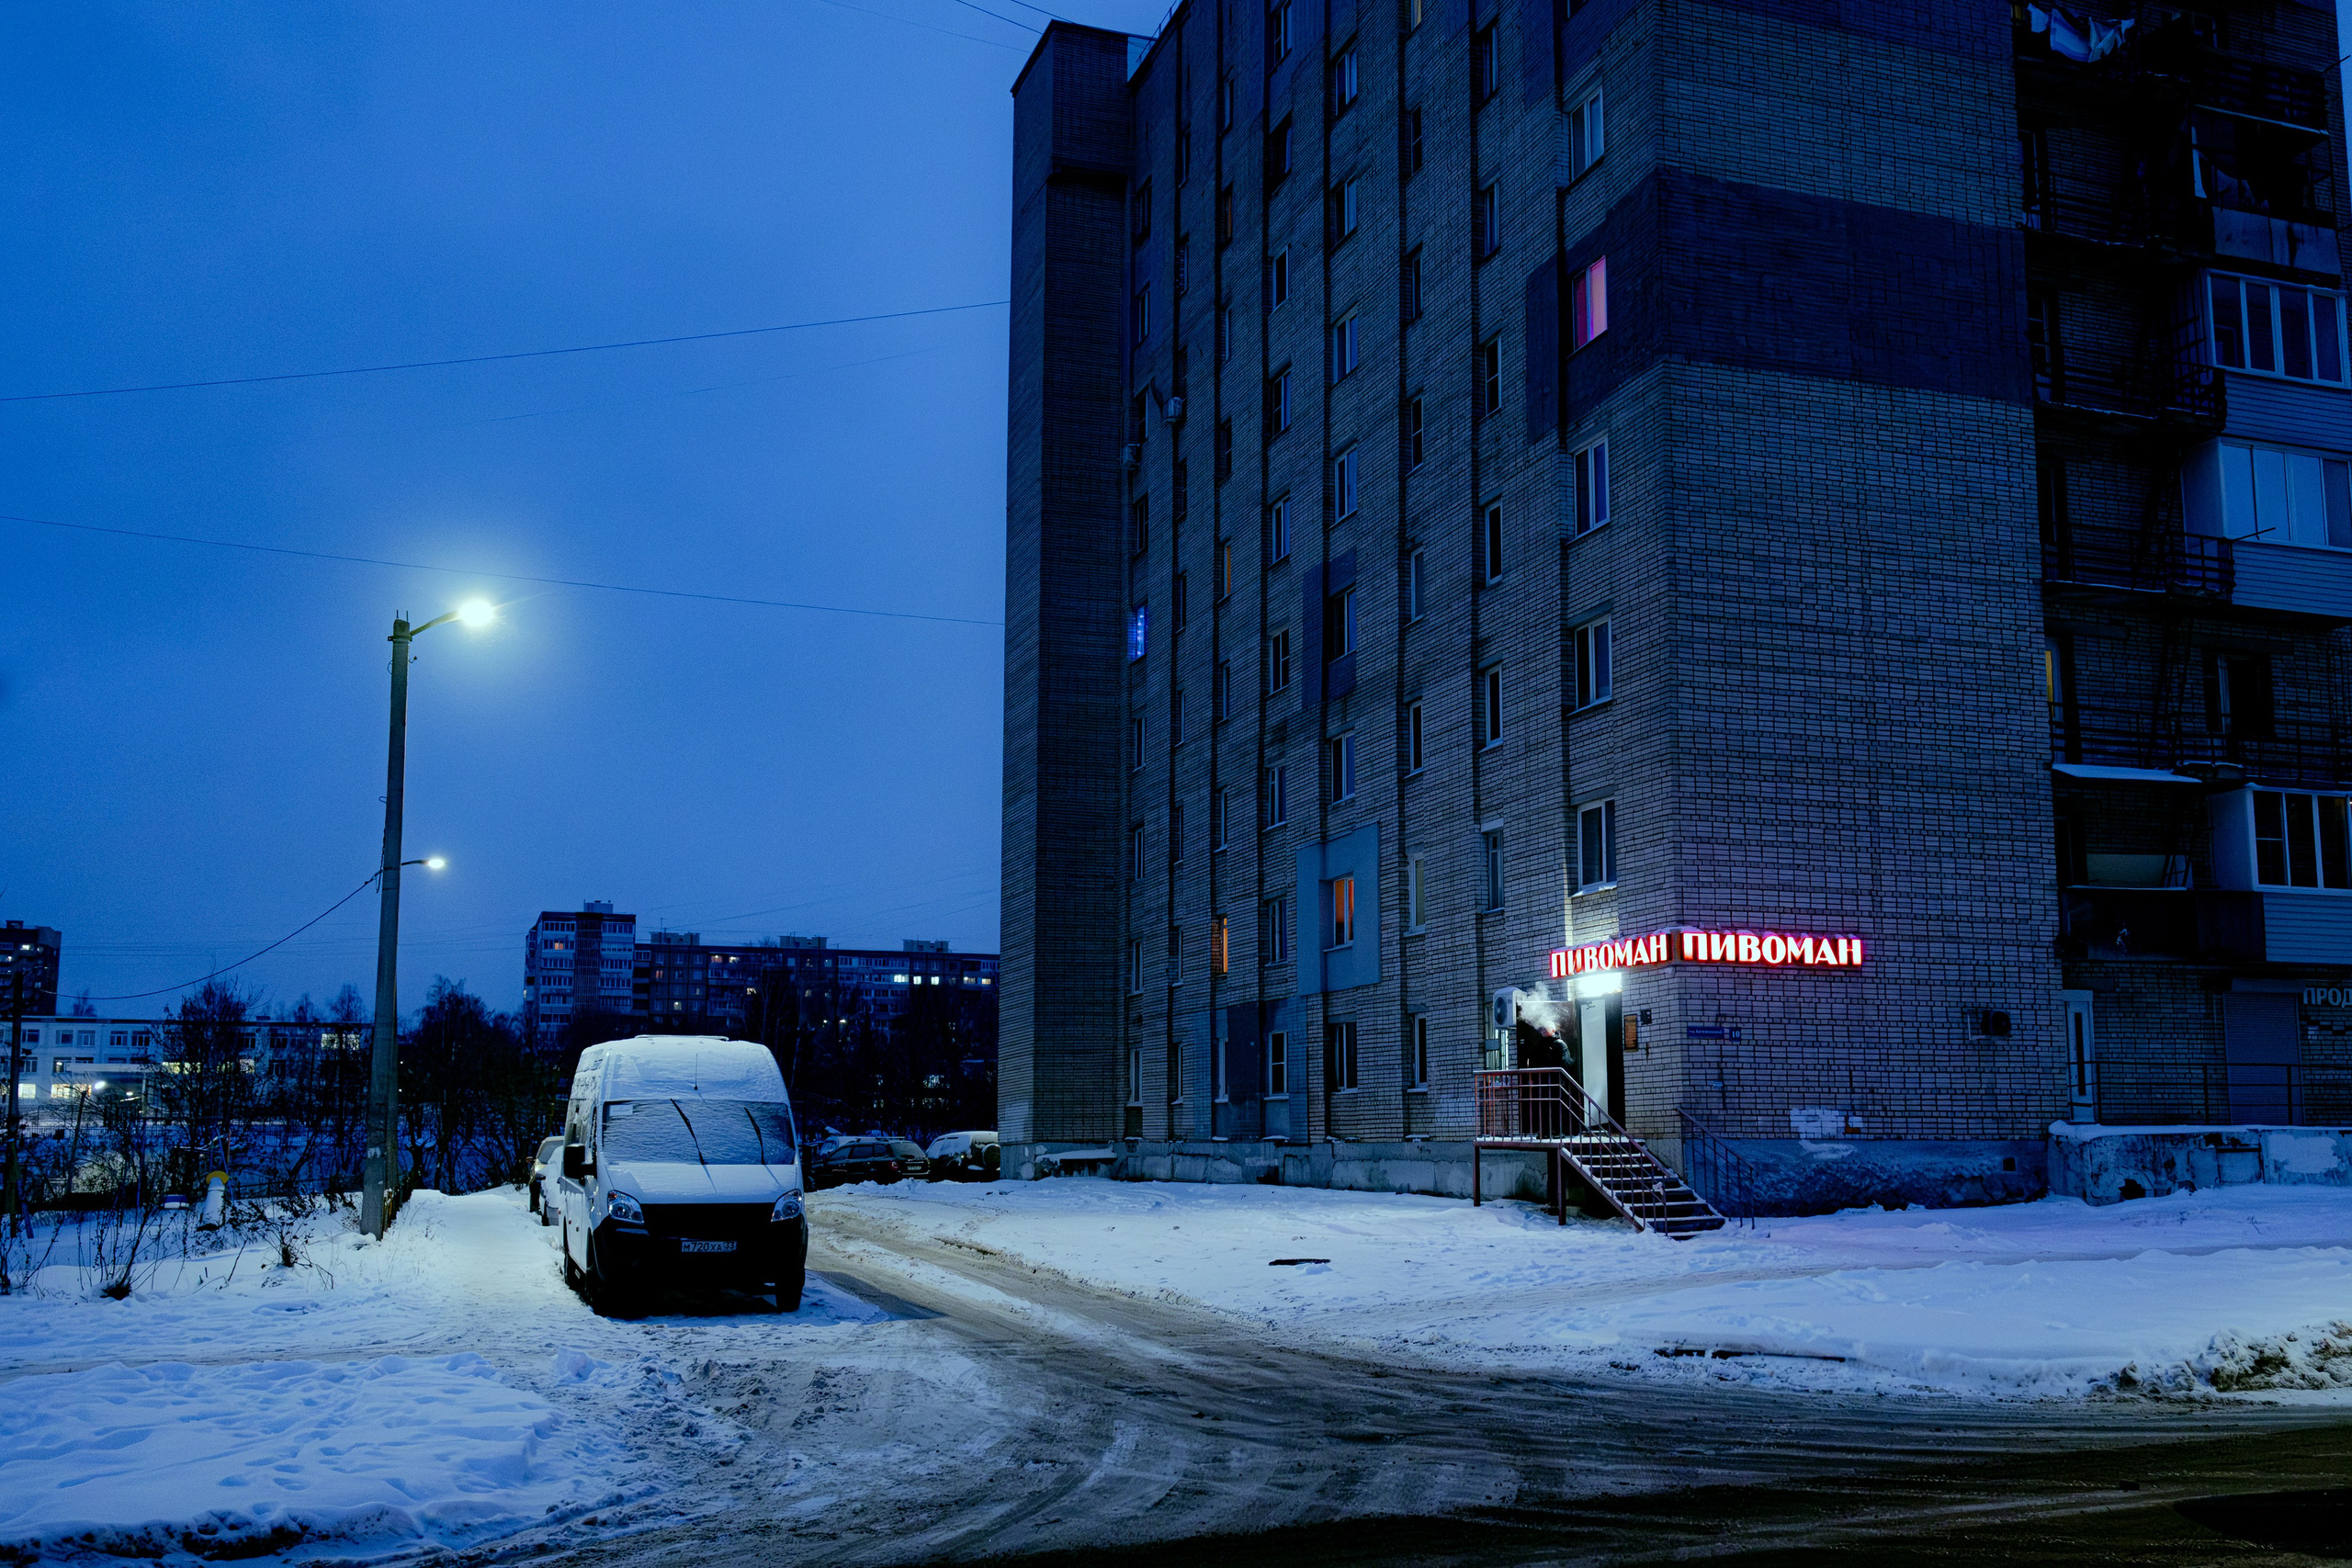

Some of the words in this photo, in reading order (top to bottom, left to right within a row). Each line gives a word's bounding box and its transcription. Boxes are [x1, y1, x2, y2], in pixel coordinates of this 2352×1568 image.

[1551, 933, 1668, 977] ПИВОМАН
[1682, 932, 1862, 965] ПИВОМАН
[1732, 1030, 1740, 1039] 10
